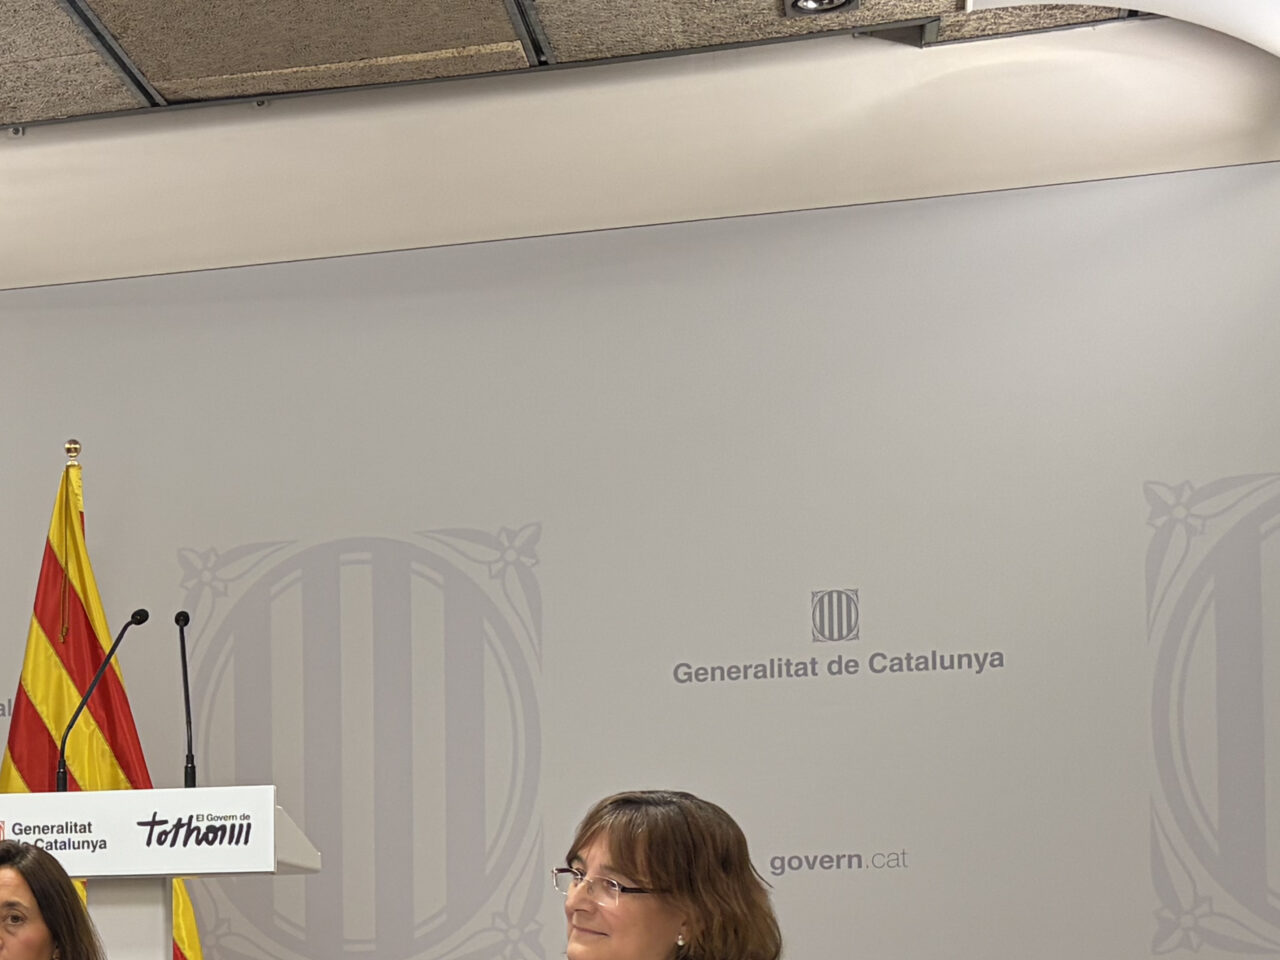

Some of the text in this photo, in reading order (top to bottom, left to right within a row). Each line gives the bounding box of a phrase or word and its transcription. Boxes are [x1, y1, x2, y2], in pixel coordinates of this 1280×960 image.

[673, 650, 1005, 684] Generalitat de Catalunya
[195, 813, 251, 822] El Govern de
[11, 821, 93, 836] Generalitat
[34, 837, 108, 853] Catalunya
[770, 849, 909, 876] govern.cat
